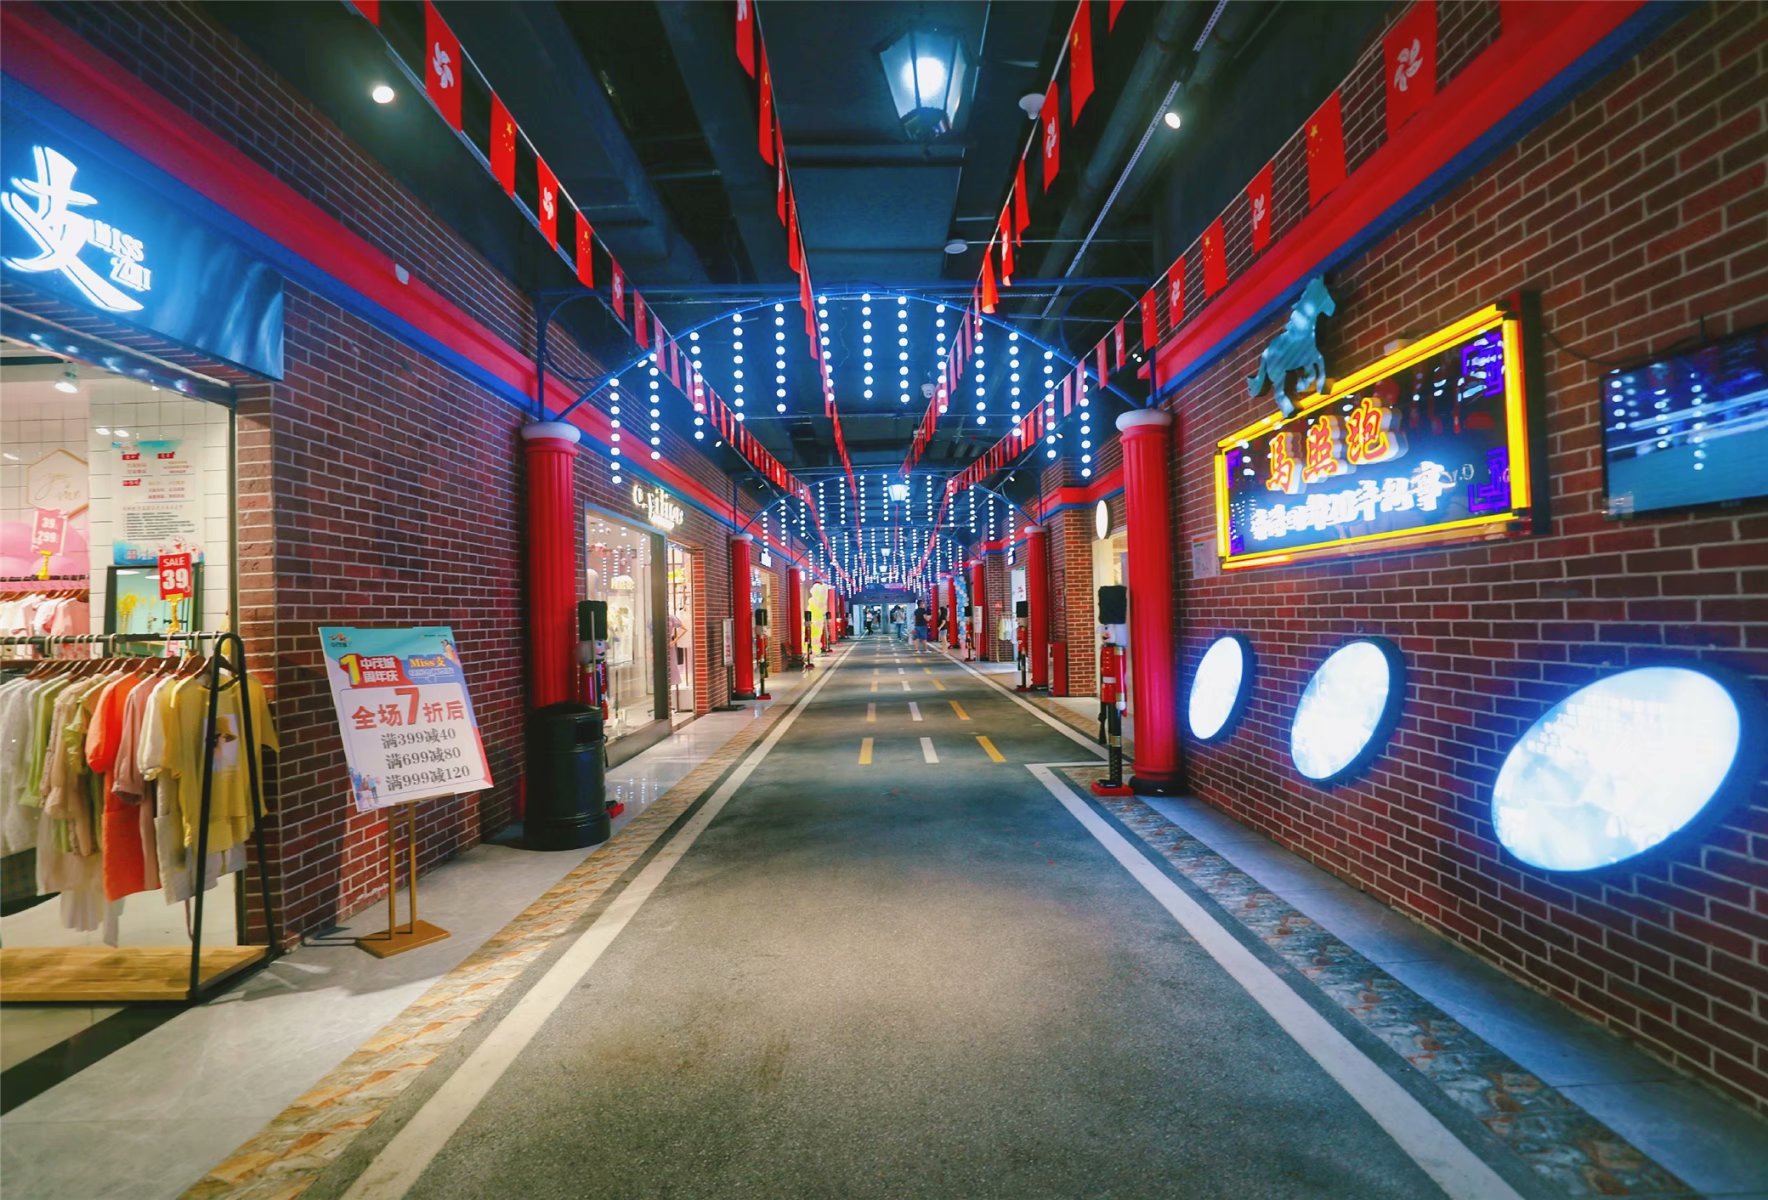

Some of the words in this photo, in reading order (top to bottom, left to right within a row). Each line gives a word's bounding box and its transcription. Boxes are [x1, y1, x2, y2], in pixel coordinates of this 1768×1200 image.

[162, 556, 186, 567] SALE
[162, 568, 189, 590] 39
[340, 654, 361, 685] 1
[352, 687, 464, 730] 全场7折后
[380, 728, 457, 749] 满399减40
[385, 747, 461, 770] 满699减80
[385, 765, 470, 791] 满999减120
